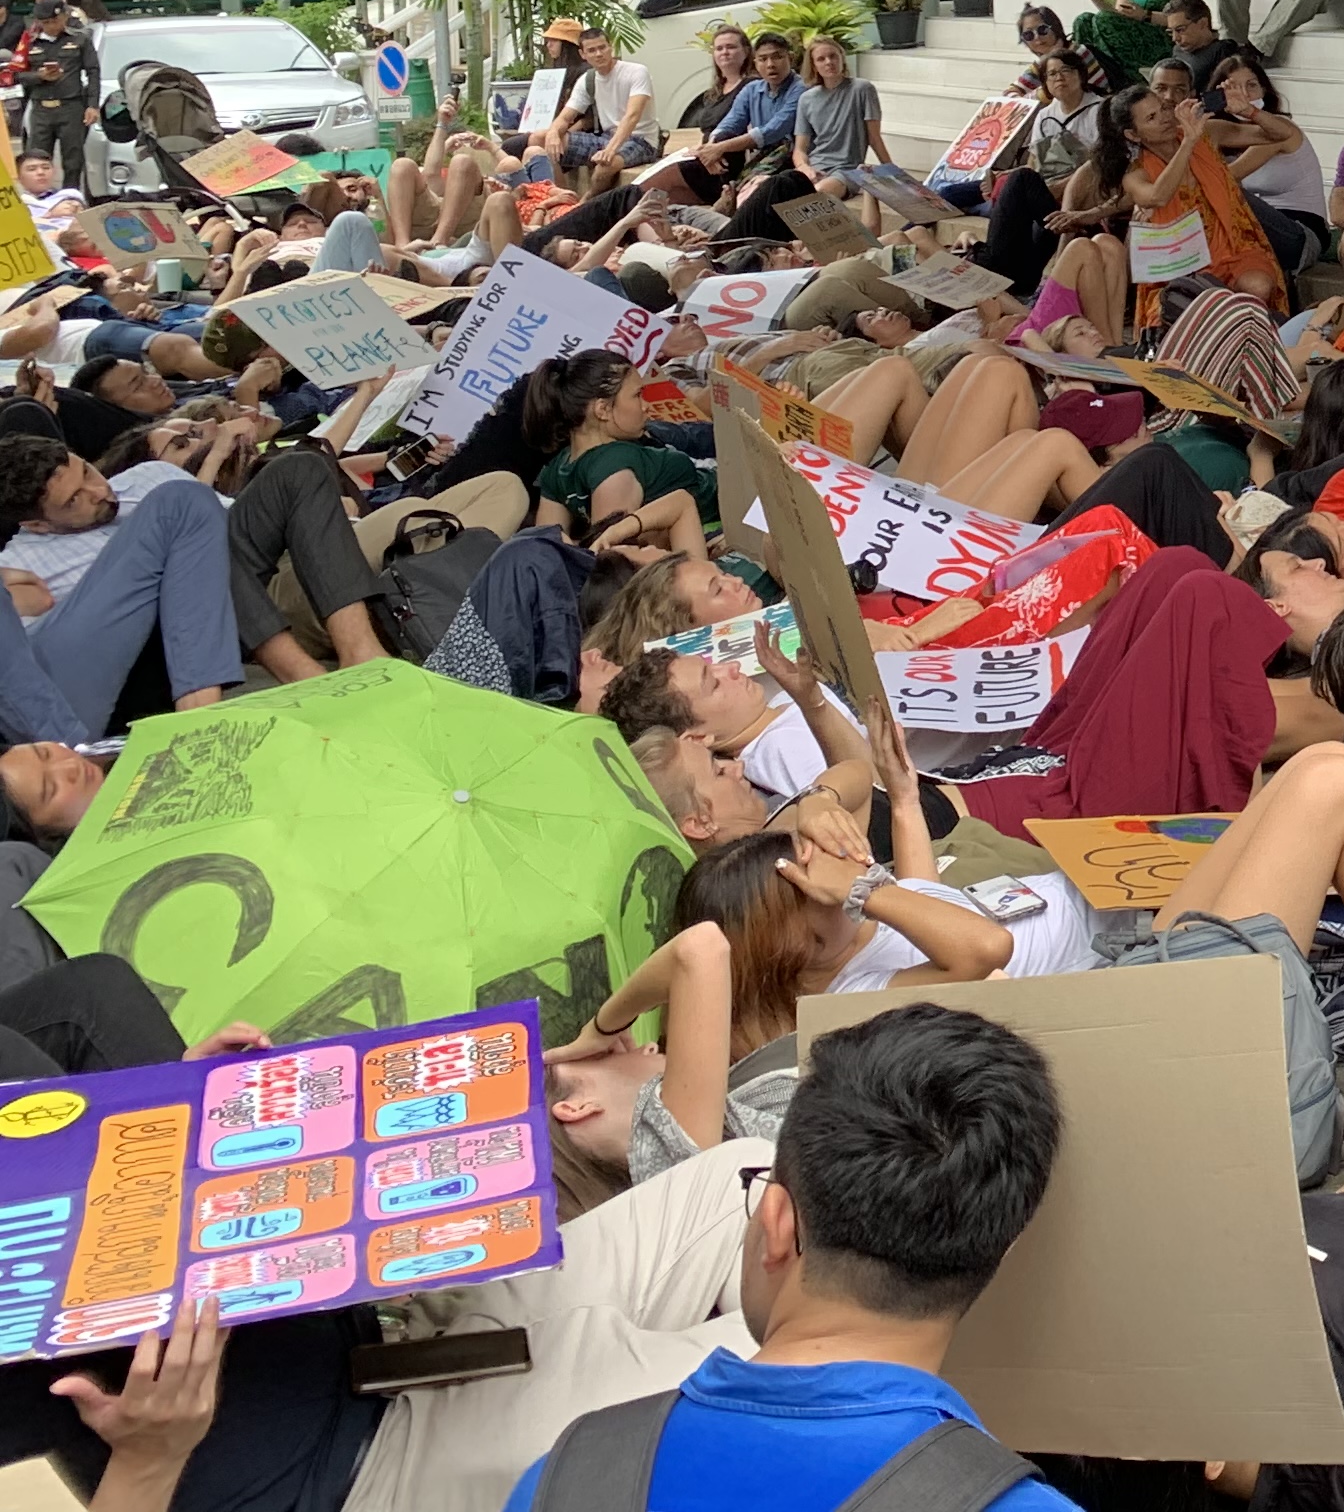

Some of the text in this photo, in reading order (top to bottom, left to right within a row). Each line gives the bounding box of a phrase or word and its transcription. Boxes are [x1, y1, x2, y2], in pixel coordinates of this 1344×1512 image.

[954, 150, 983, 165] SOS
[256, 287, 366, 330] PROTEST
[704, 279, 768, 339] NO
[405, 259, 524, 431] I'M STUDYING FOR A
[459, 304, 549, 405] FUTURE
[860, 518, 905, 572] OUR
[922, 508, 953, 534] IS
[925, 510, 1024, 596] DYING
[899, 654, 959, 724] IT'S OUR
[975, 646, 1043, 726] FUTURE
